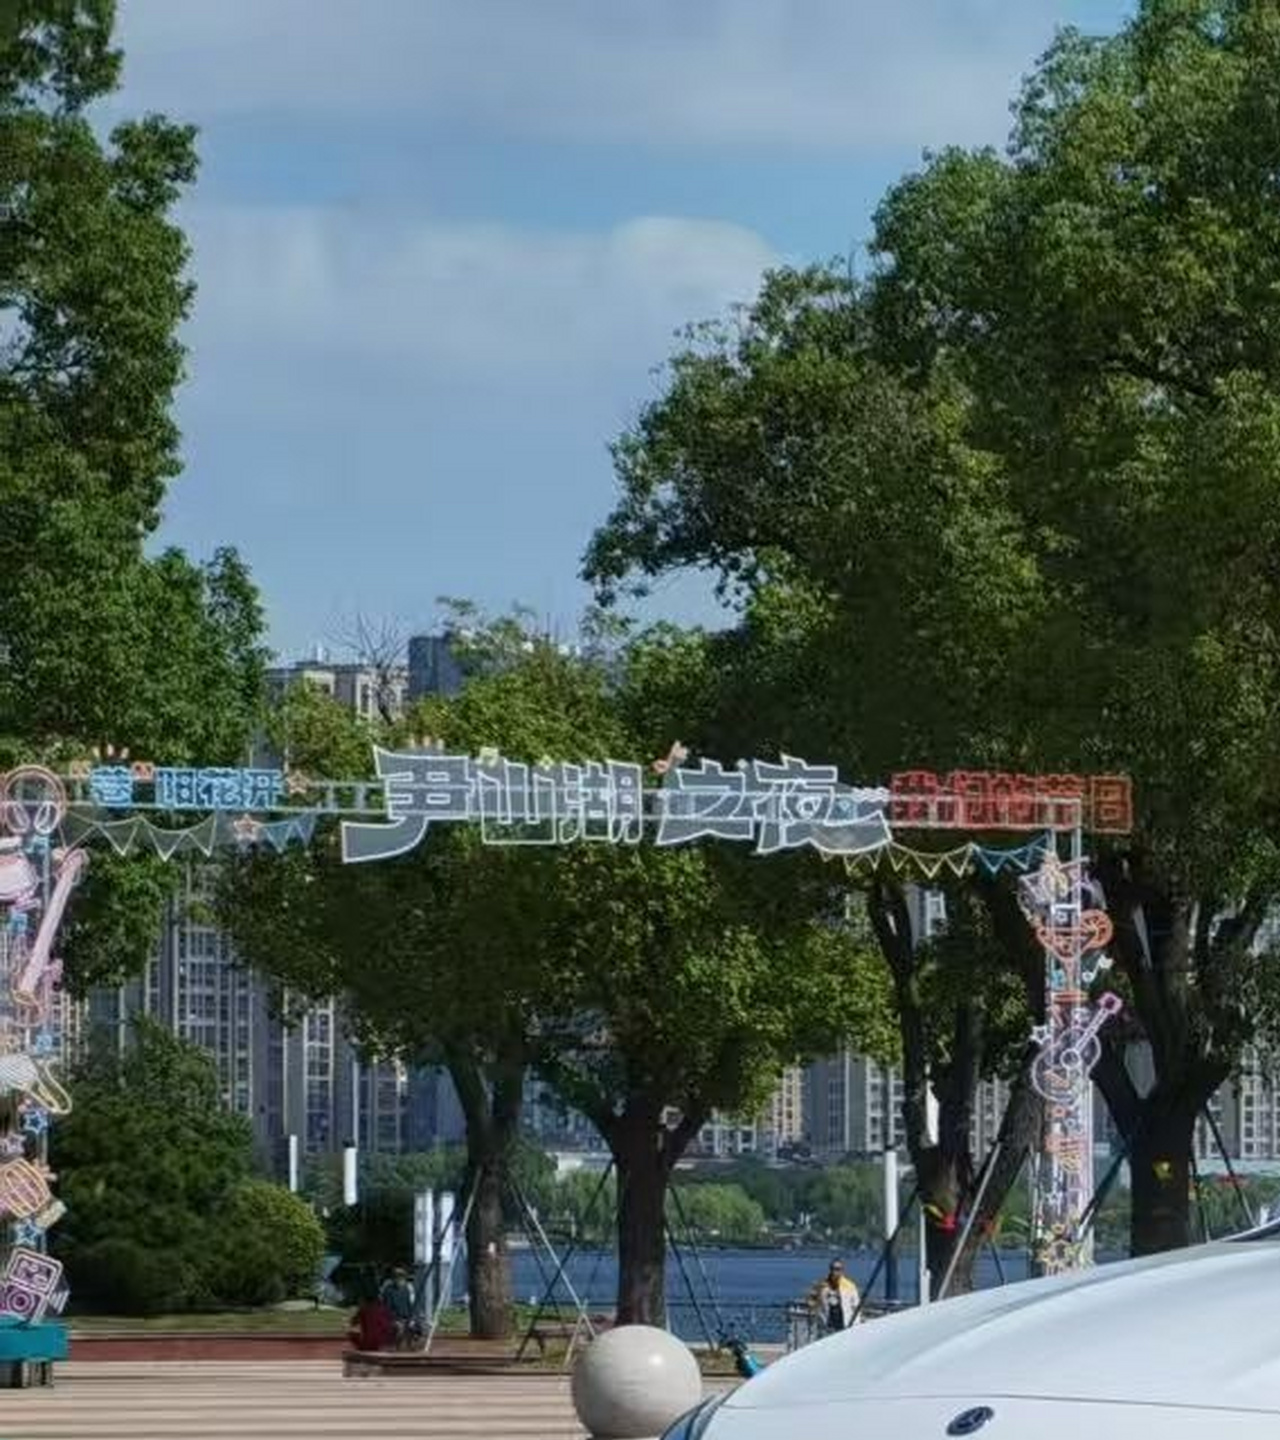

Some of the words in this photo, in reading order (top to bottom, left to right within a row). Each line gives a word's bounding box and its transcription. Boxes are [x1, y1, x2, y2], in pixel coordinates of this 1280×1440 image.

[342, 745, 893, 863] 尹山湖之夜
